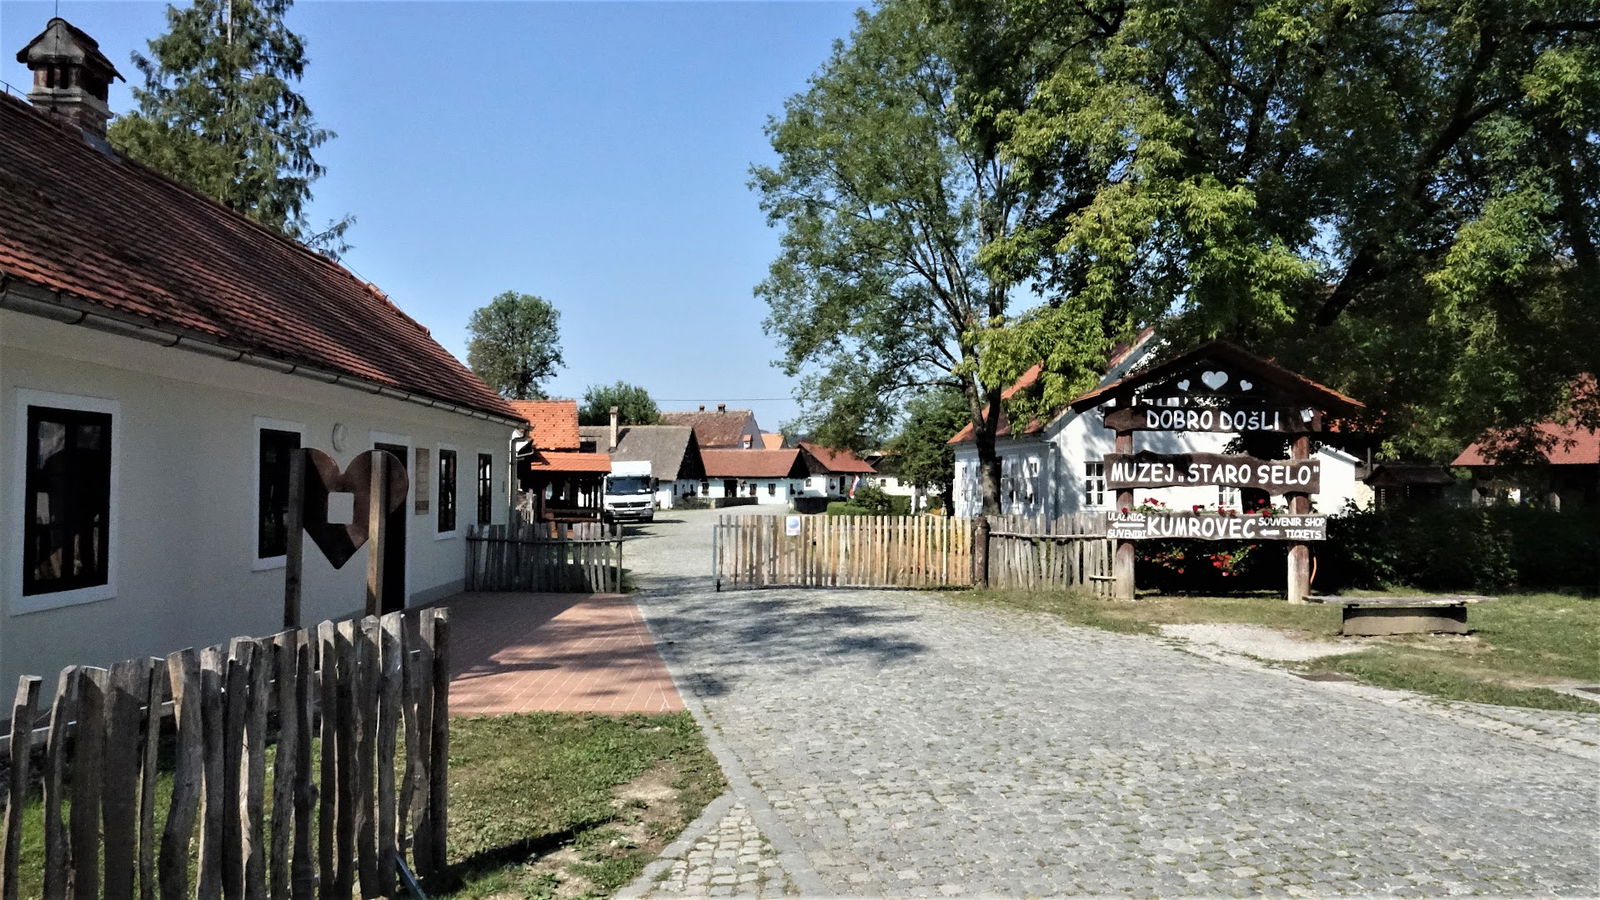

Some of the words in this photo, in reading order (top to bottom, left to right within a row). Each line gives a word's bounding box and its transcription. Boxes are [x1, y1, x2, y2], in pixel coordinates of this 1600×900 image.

[1146, 409, 1213, 430] DOBRO
[1219, 410, 1280, 431] DOŠLI
[1110, 462, 1175, 483] MUZEJ
[1147, 515, 1256, 539] KUMROVEC
[1258, 516, 1302, 527] SOUVENIR
[1304, 517, 1325, 527] SHOP
[1284, 529, 1322, 539] TICKETS
